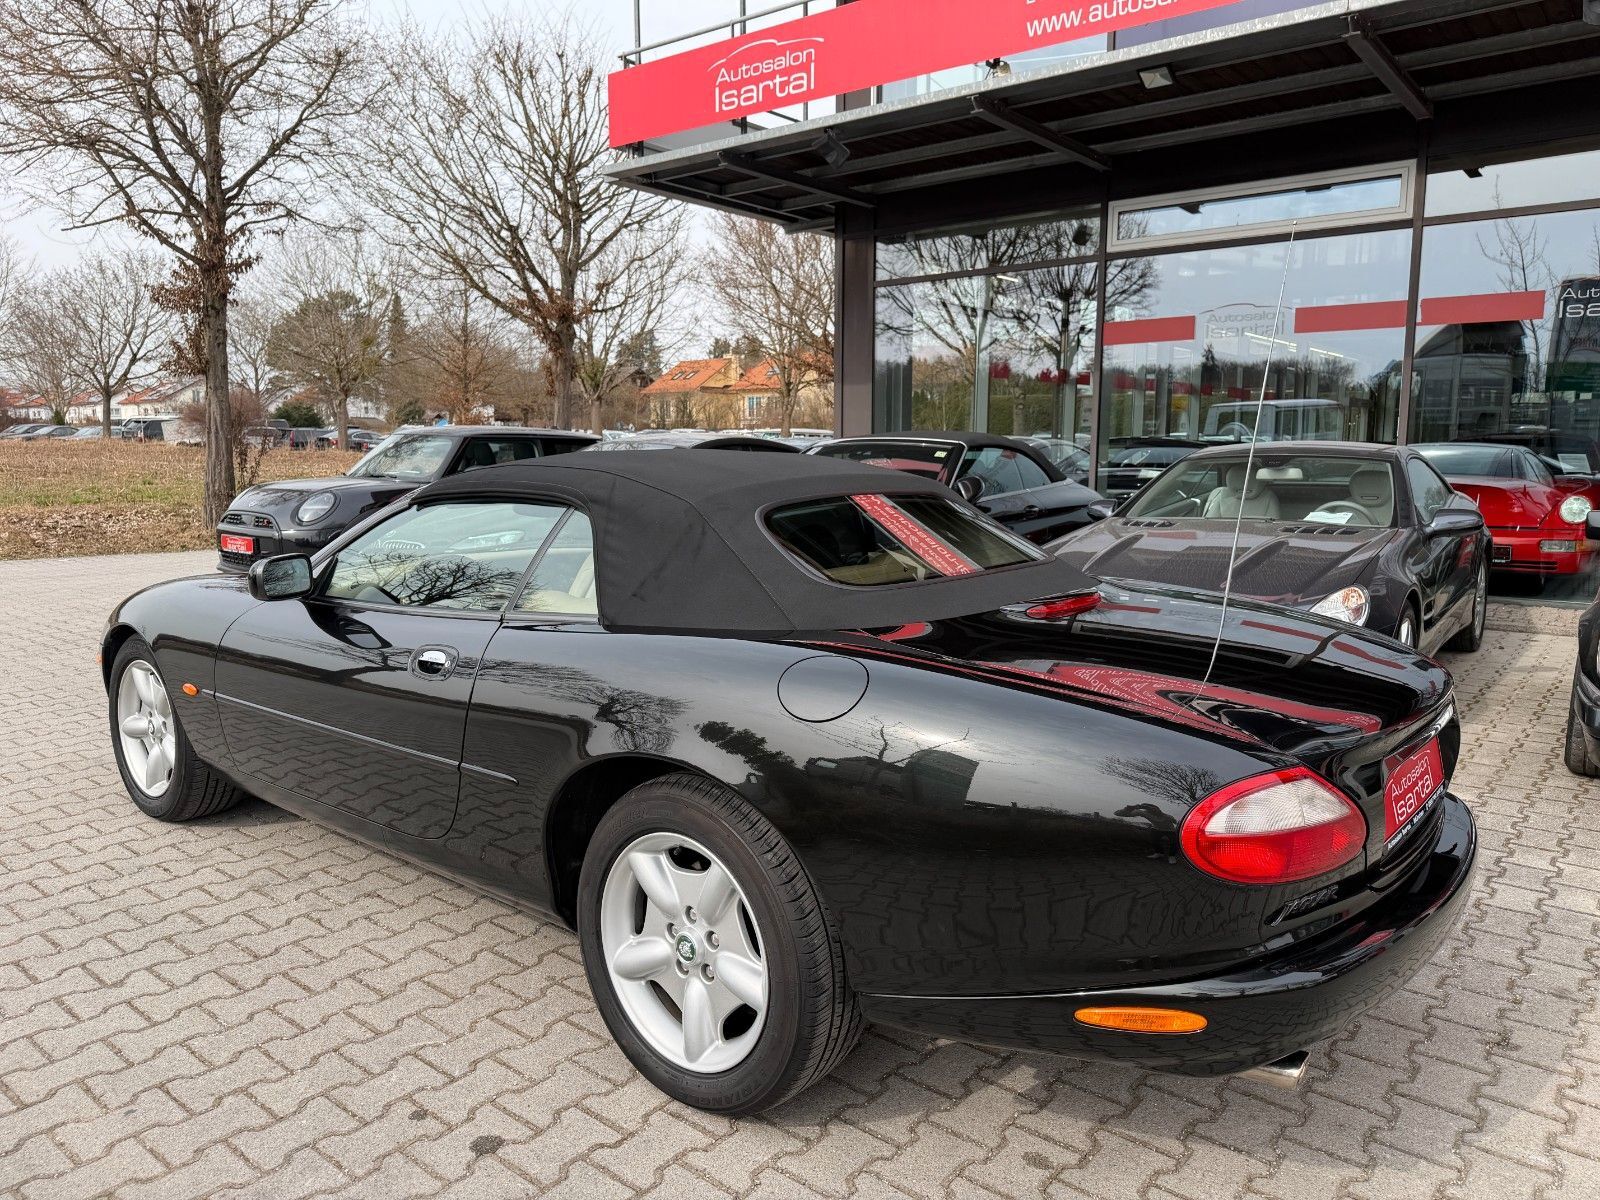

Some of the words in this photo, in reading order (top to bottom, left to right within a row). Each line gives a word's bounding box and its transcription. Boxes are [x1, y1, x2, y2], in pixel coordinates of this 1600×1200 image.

[1026, 0, 1177, 37] www.autos
[714, 61, 815, 113] Isartal
[715, 48, 815, 86] Autosalon
[1560, 287, 1600, 300] Aut
[1392, 756, 1430, 800] Autosalon
[1393, 765, 1434, 825] Isartal
